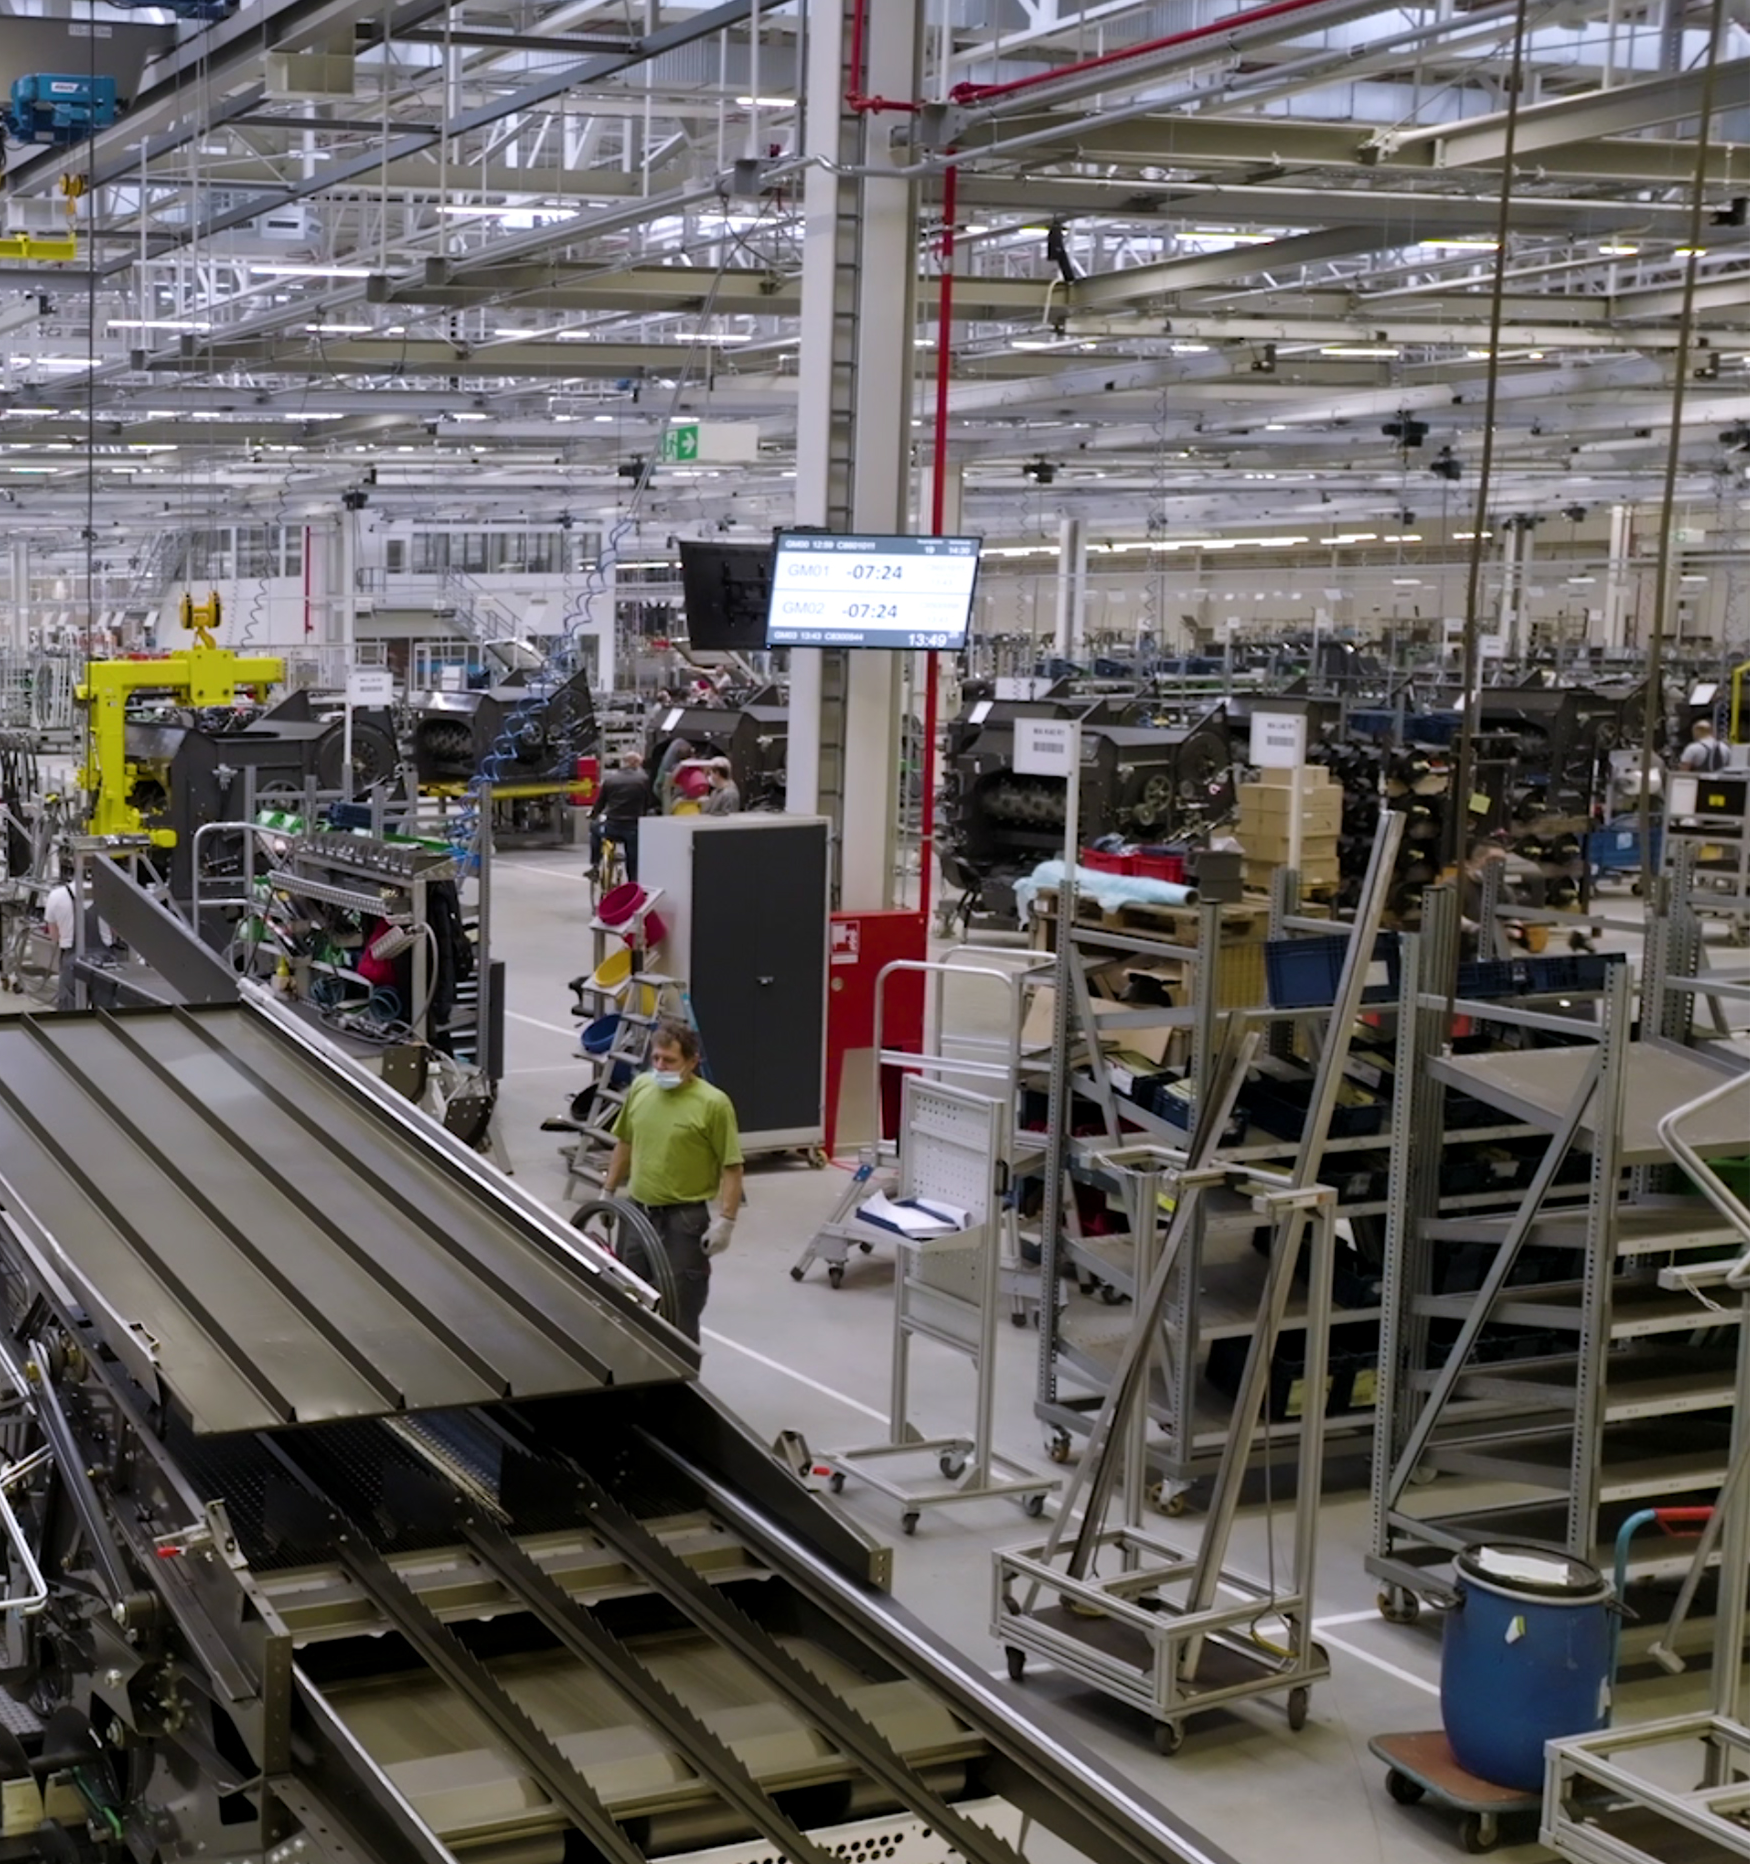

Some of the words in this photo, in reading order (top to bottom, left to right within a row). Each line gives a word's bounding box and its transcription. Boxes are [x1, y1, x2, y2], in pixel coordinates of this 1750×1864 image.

[787, 562, 830, 577] GM01
[846, 563, 903, 580] -07:24
[782, 600, 825, 614] GM02
[842, 602, 898, 619] -07:24
[908, 633, 947, 648] 13:49
